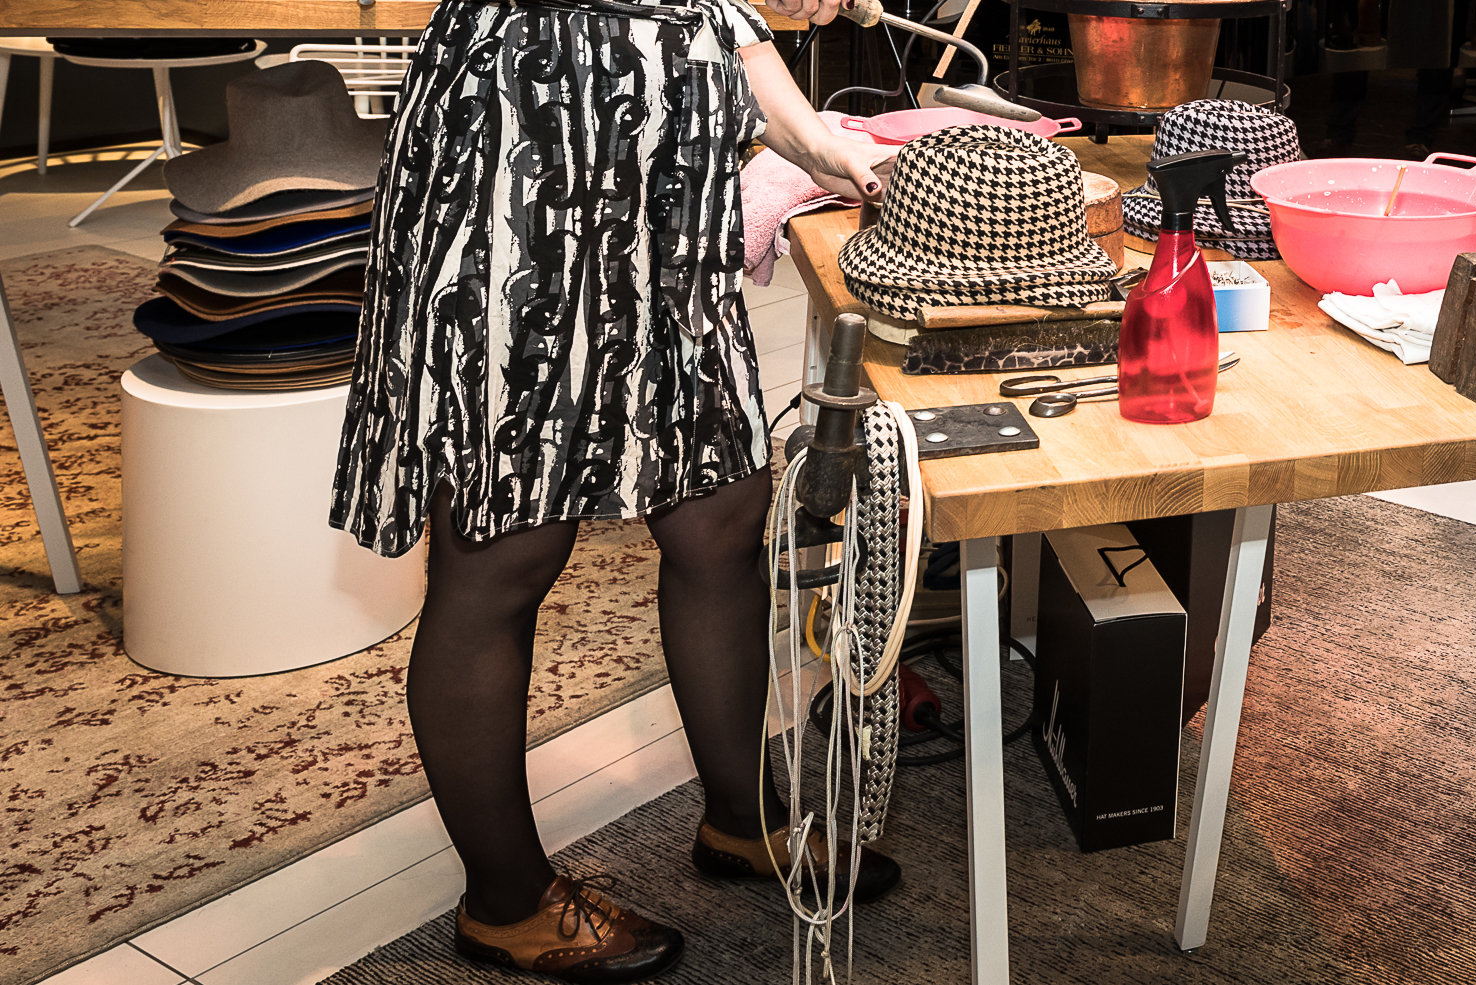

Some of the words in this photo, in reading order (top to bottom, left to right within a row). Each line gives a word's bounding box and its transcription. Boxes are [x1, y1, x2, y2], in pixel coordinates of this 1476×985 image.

[1096, 813, 1108, 821] HAT
[1108, 810, 1131, 819] MAKERS
[1132, 807, 1149, 816] SINCE
[1150, 804, 1164, 813] 1903
